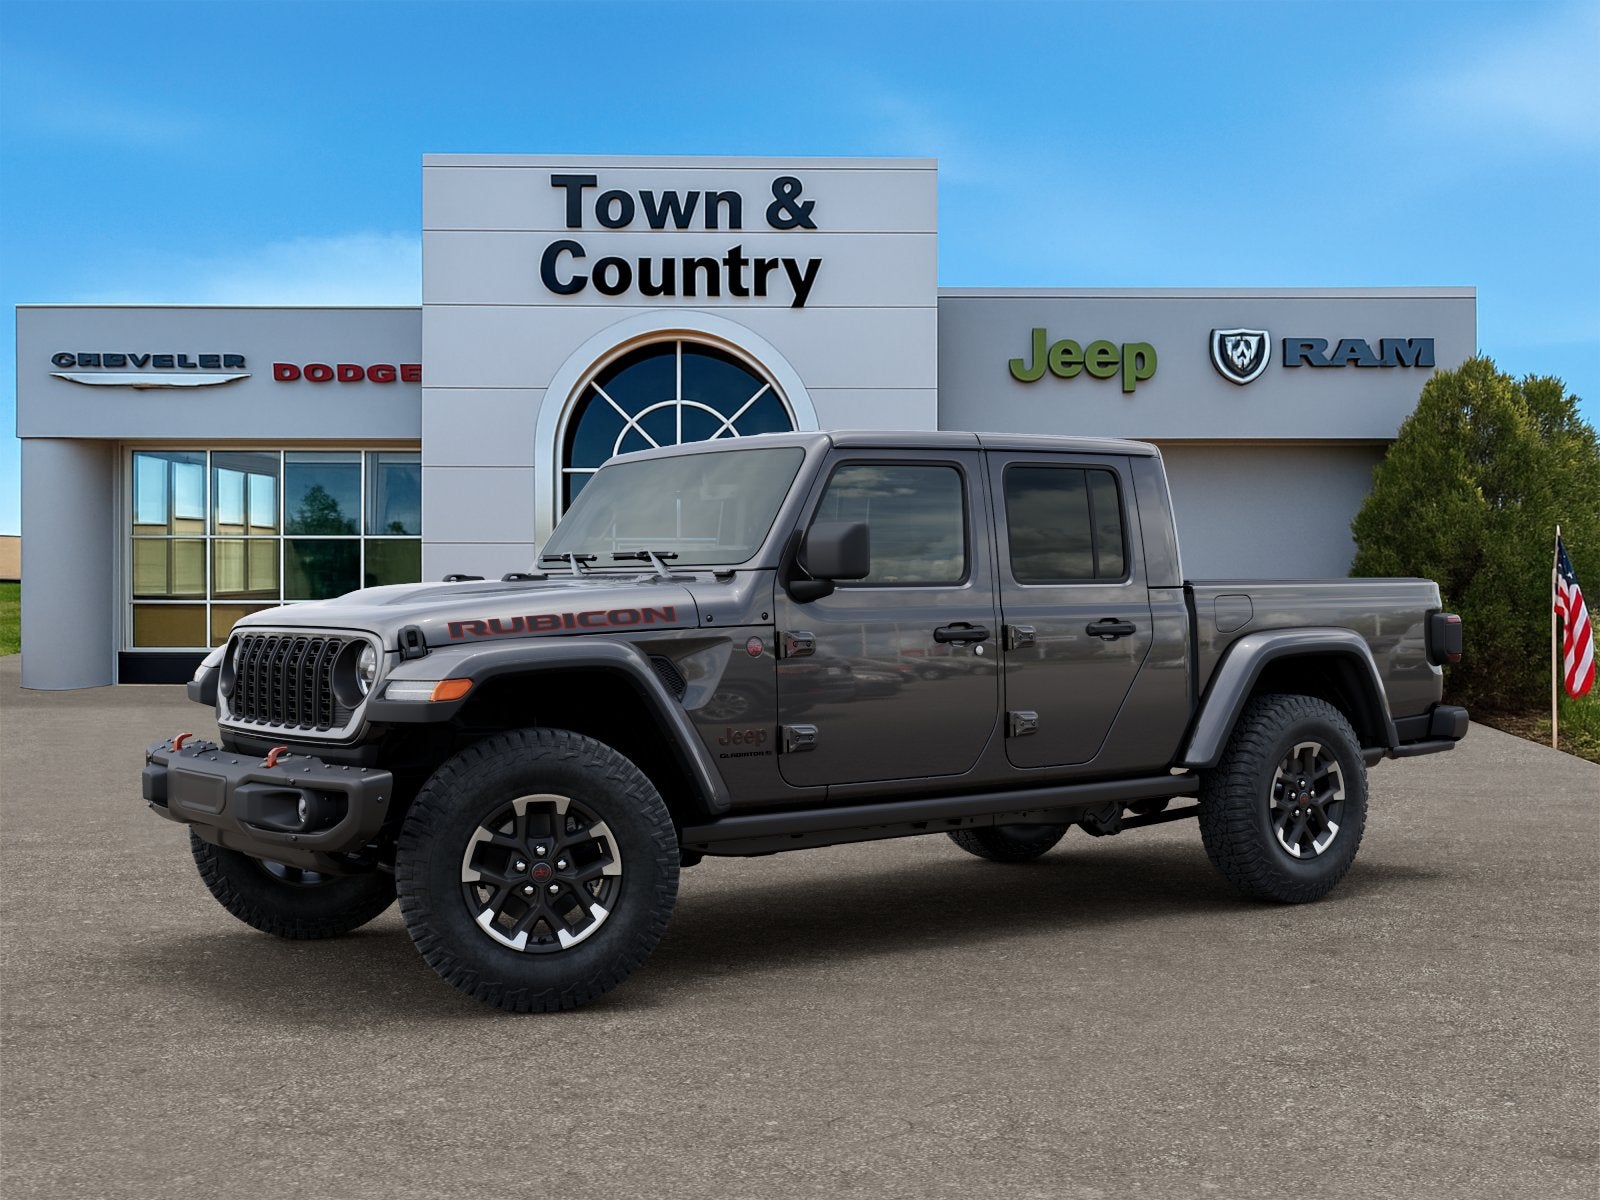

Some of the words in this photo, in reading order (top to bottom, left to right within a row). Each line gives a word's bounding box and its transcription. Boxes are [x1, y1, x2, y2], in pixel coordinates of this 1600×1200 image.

[550, 174, 742, 229] Town
[766, 176, 818, 230] &
[540, 239, 823, 308] Country
[1009, 327, 1157, 393] Jeep
[1282, 337, 1436, 368] RAM
[273, 363, 422, 383] DODGE
[447, 606, 677, 639] RUBICON
[718, 727, 767, 747] Jeep
